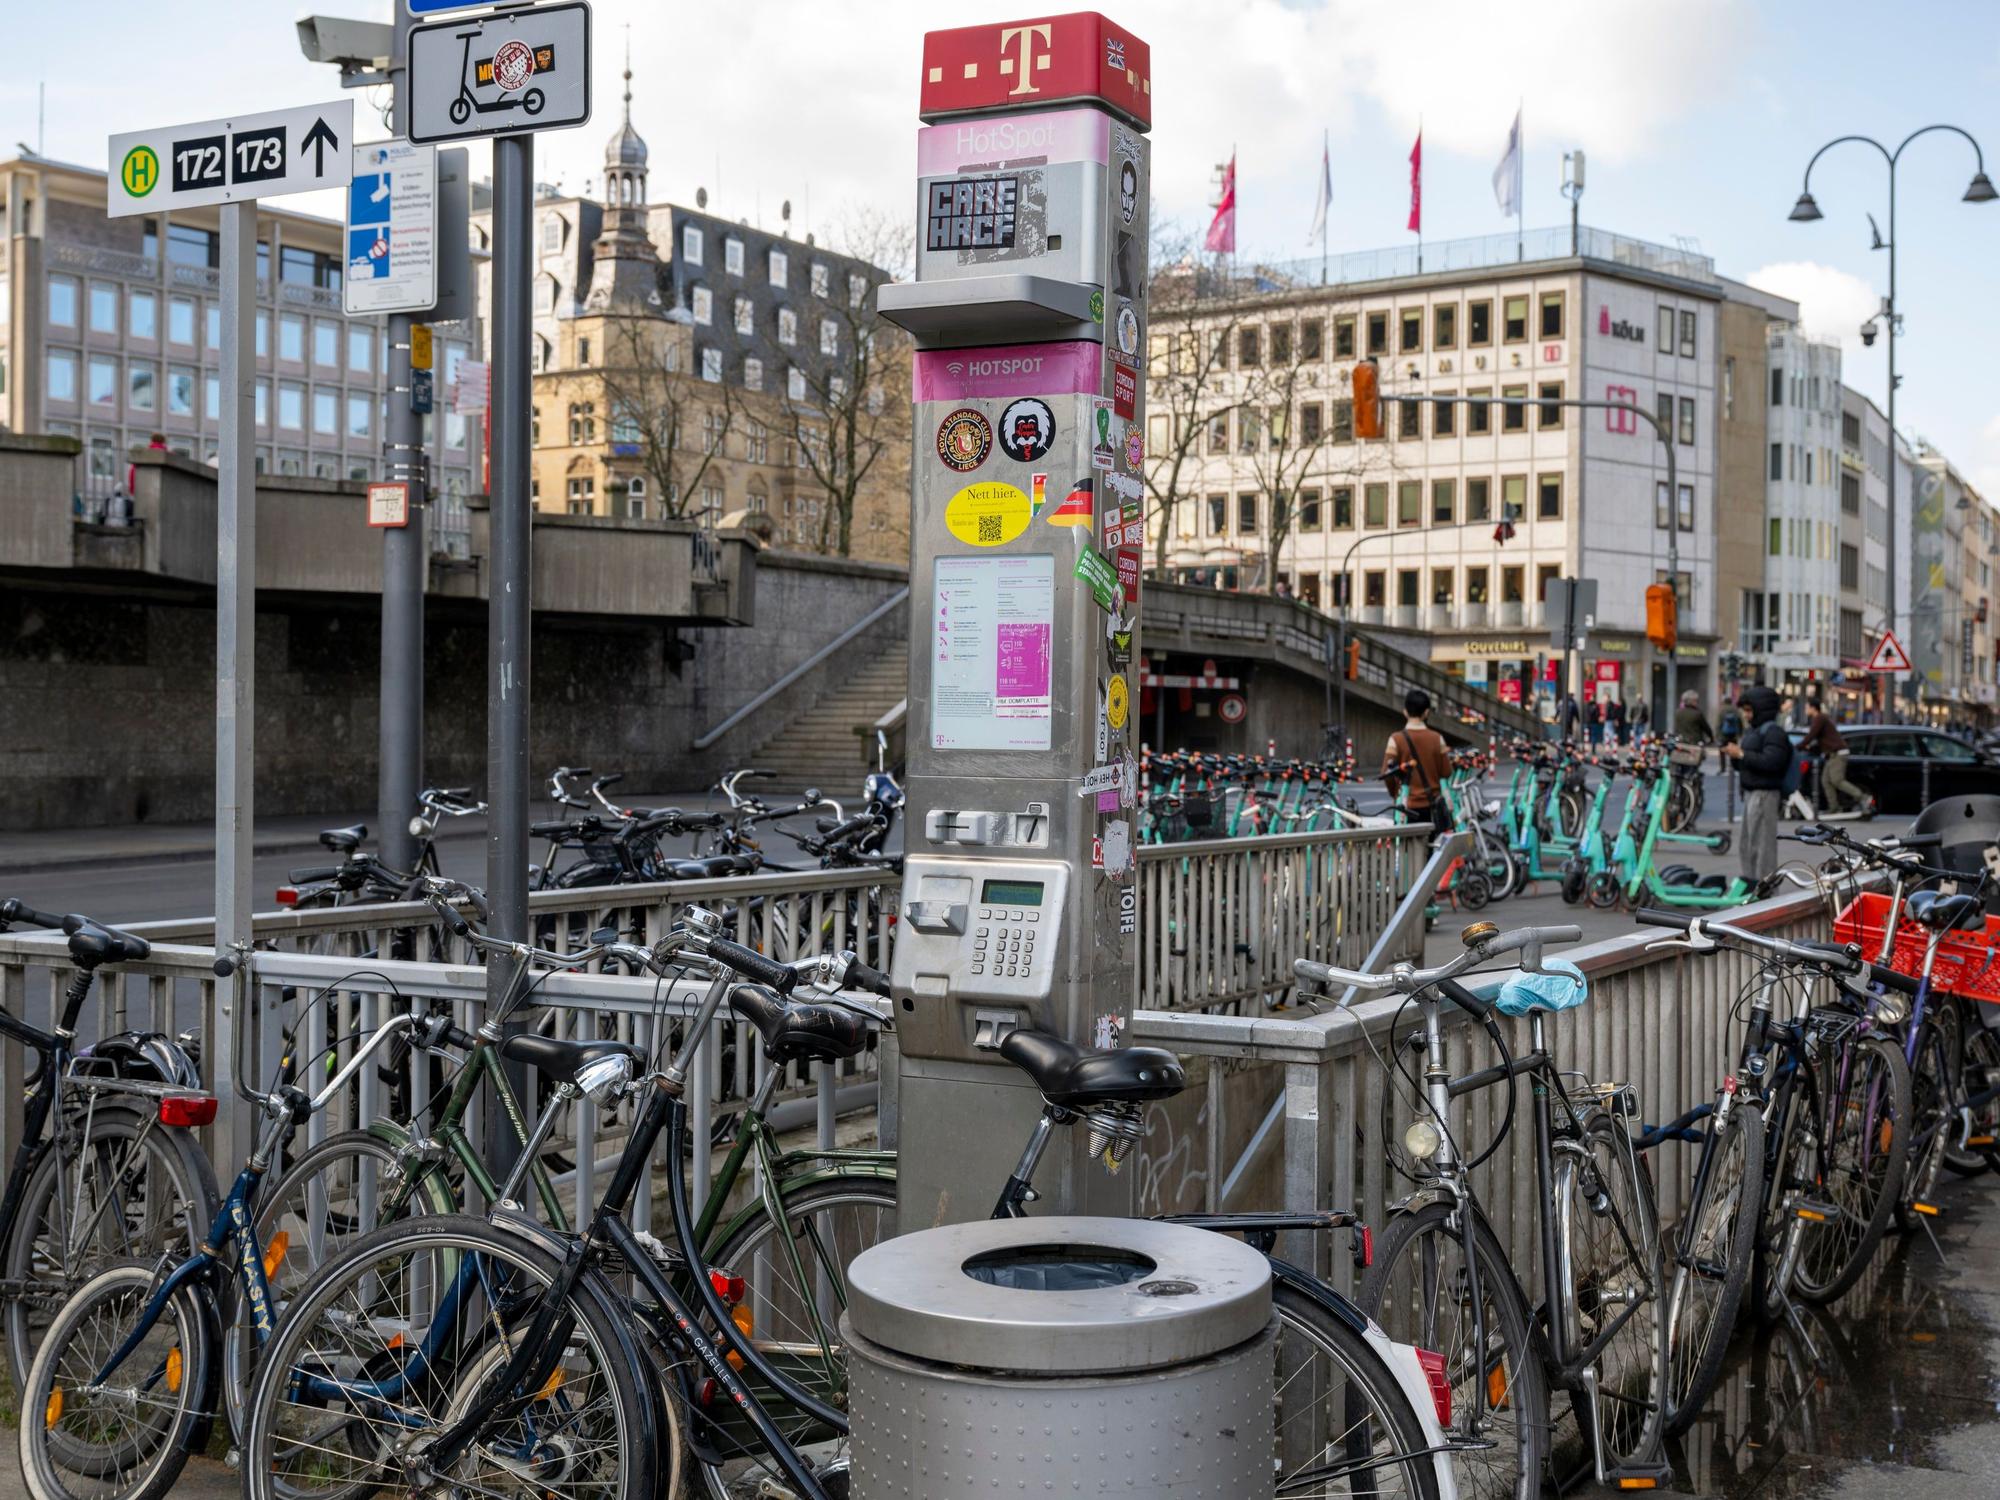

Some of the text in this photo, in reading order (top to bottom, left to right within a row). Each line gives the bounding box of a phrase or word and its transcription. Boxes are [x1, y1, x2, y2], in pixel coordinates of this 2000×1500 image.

[1000, 23, 1052, 96] T
[956, 122, 1056, 155] HotSpot
[131, 137, 282, 189] H 172 173
[1611, 318, 1646, 343] KÖLN
[968, 357, 1044, 377] HOTSPOT
[1116, 371, 1135, 389] CORDON
[1115, 386, 1134, 403] SPORT
[938, 429, 947, 454] ROYAL
[945, 411, 981, 427] STANDARD
[980, 419, 991, 442] CLUB
[958, 460, 978, 471] LIEGE
[967, 487, 1017, 500] Nett hier.
[1119, 556, 1138, 572] CORDON
[1118, 570, 1137, 586] SPORT
[1464, 640, 1528, 654] SOUVENIRS
[1120, 885, 1135, 934] TOIFE
[231, 1207, 272, 1332] DYNASTY
[694, 1337, 731, 1384] GAZELLE
